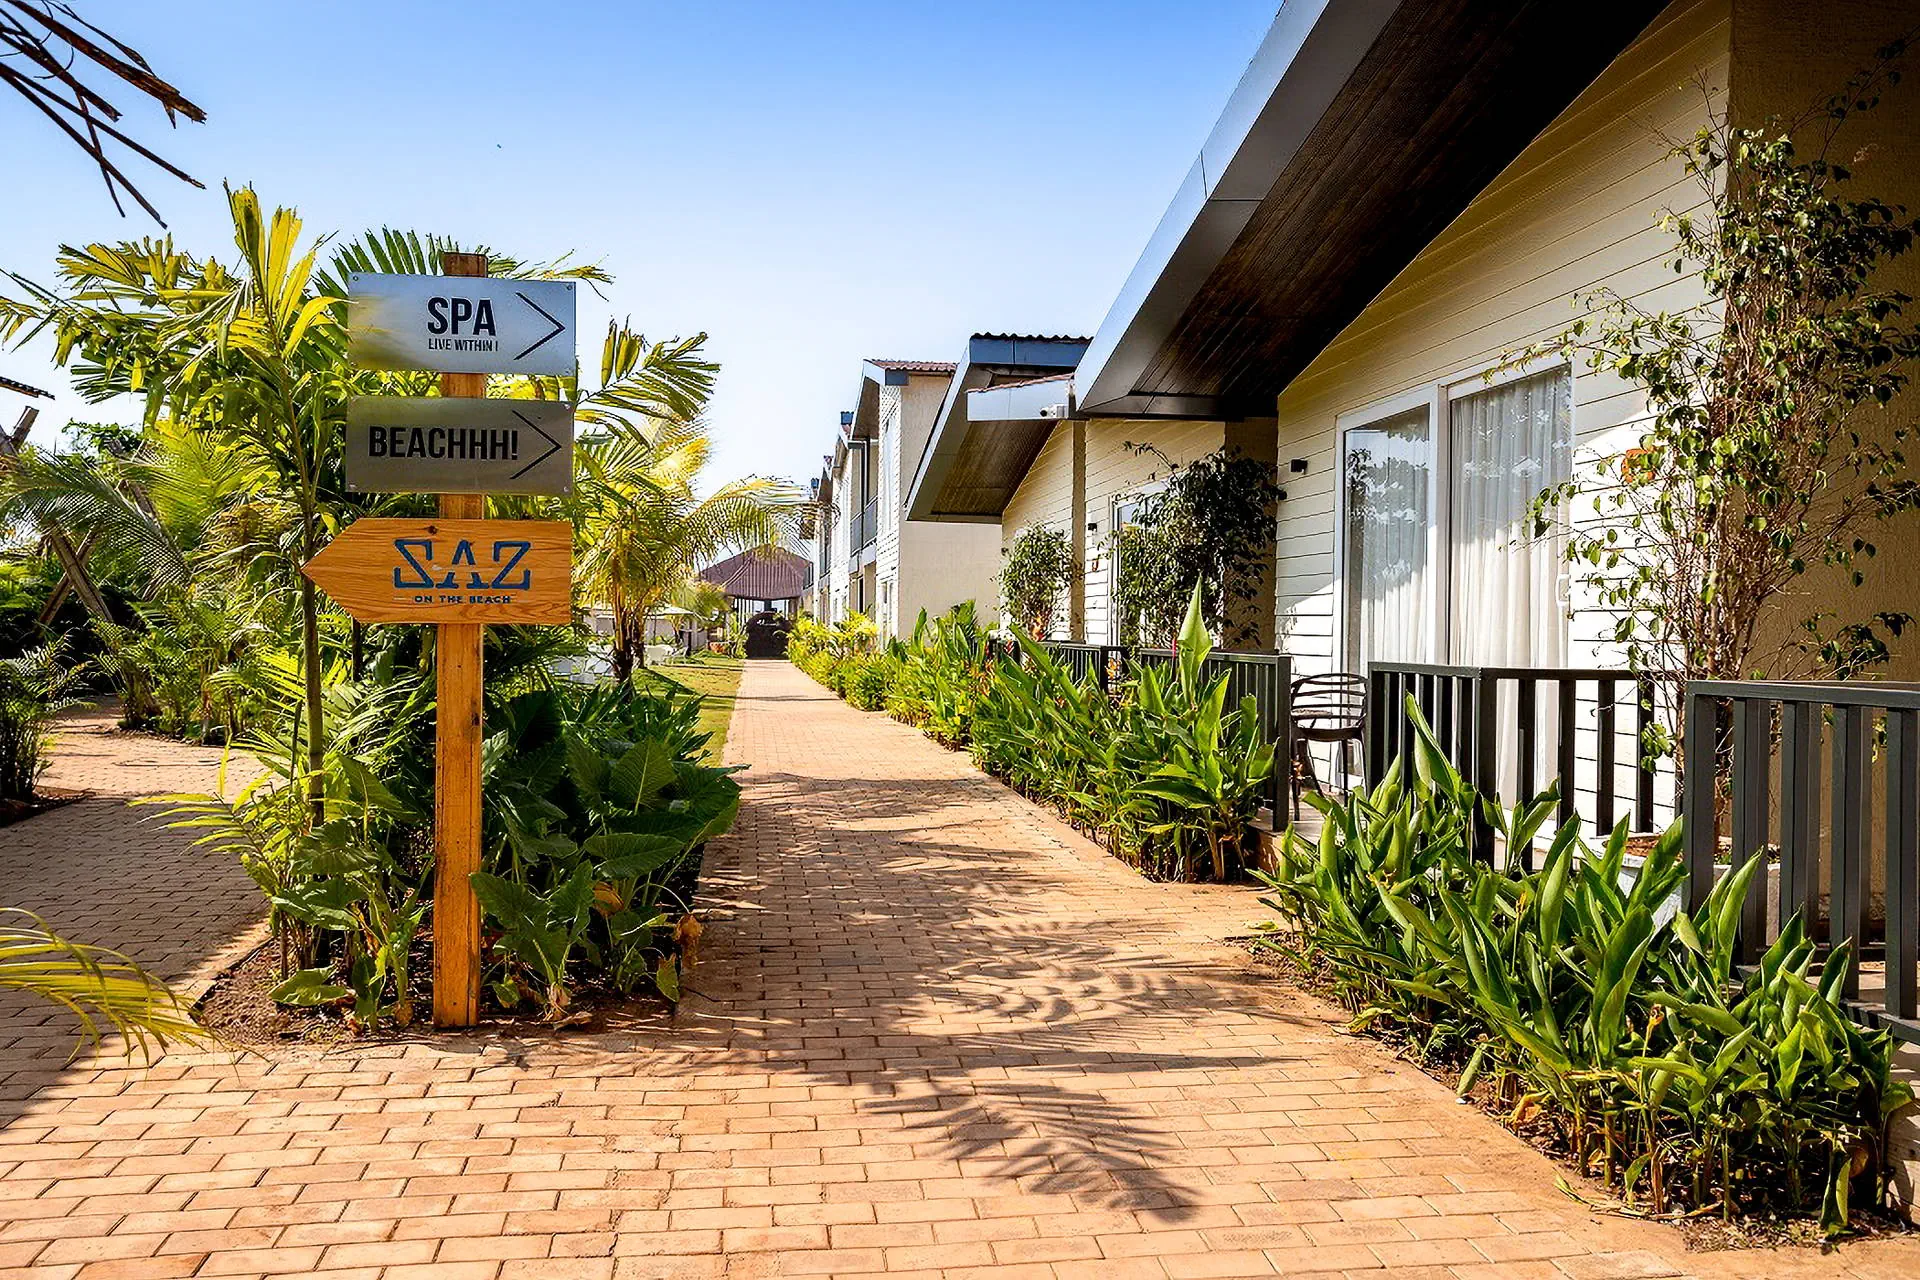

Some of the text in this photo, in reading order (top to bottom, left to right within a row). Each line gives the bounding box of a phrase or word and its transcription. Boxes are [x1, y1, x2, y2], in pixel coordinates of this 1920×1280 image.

[427, 296, 496, 336] SPA
[428, 338, 451, 350] LIVE
[454, 339, 493, 351] WITHIN
[369, 426, 518, 460] BEACHHH!
[414, 595, 511, 604] ON THE BEACH
